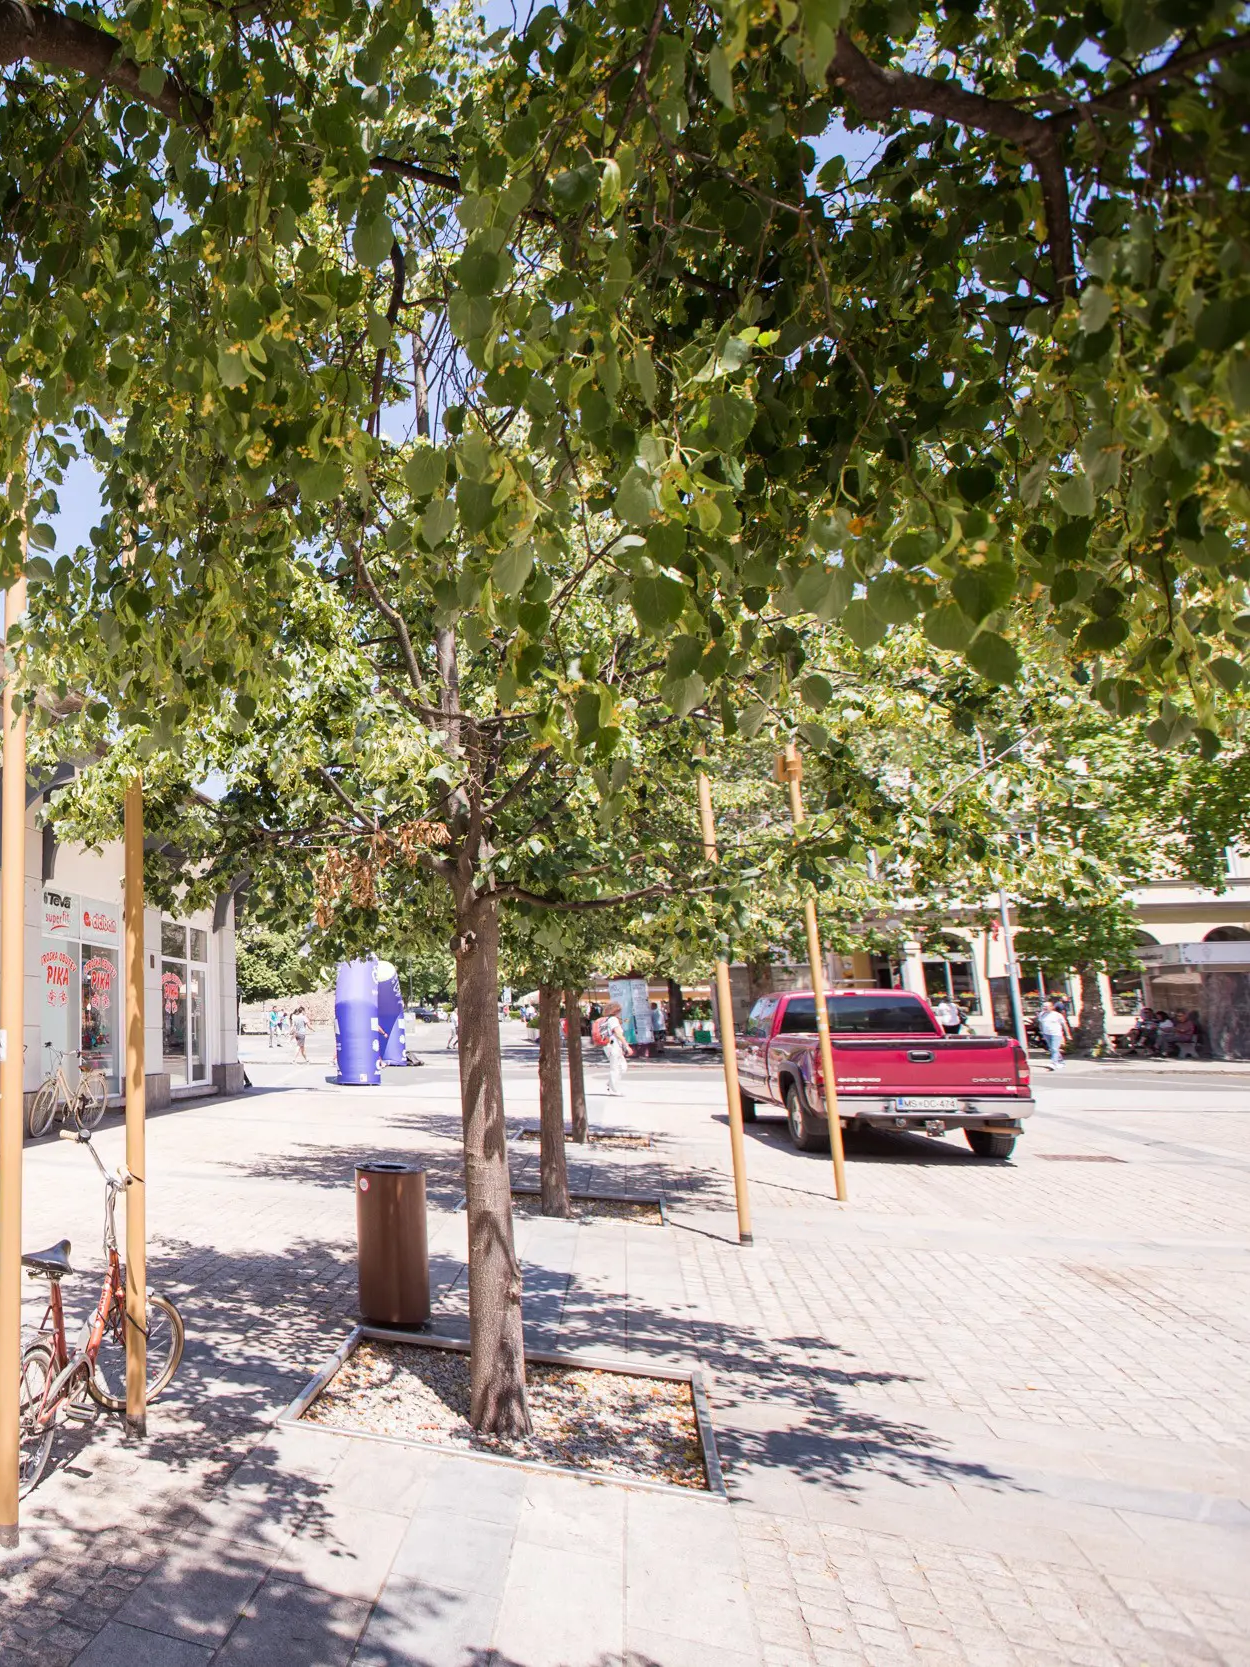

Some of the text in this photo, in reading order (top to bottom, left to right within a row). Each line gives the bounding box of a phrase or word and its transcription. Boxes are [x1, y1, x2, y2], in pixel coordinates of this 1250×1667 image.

[47, 892, 72, 909] Teva
[46, 965, 70, 987] PIKA
[91, 970, 110, 991] PIKA
